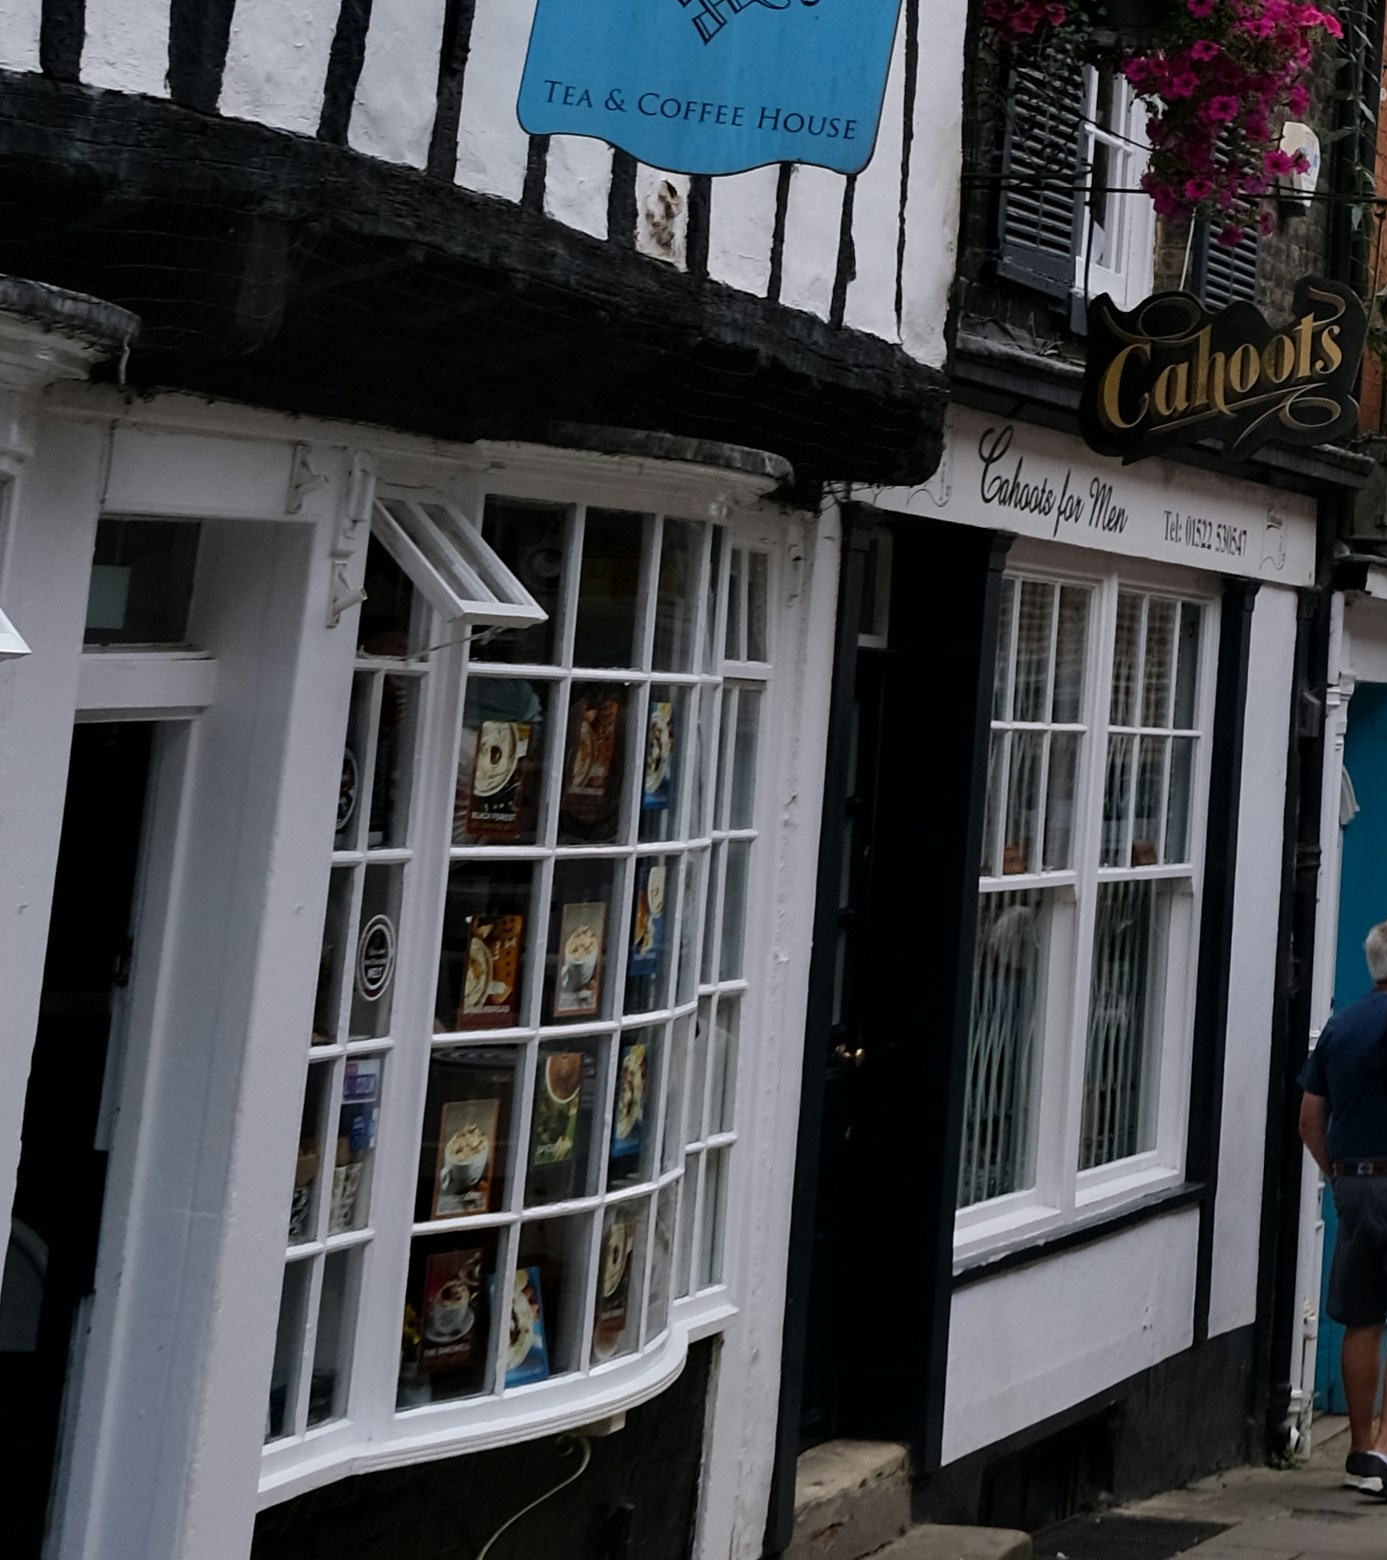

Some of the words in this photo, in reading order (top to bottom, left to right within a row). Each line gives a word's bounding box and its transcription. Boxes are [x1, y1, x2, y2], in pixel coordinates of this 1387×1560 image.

[544, 79, 594, 109] TEA
[604, 87, 627, 113] &
[637, 91, 746, 128] COFFEE
[757, 105, 858, 140] HOUSE
[1102, 312, 1343, 430] Cahoots
[978, 424, 1056, 517] Cahoots
[1052, 468, 1085, 538] for
[1089, 477, 1129, 534] Men
